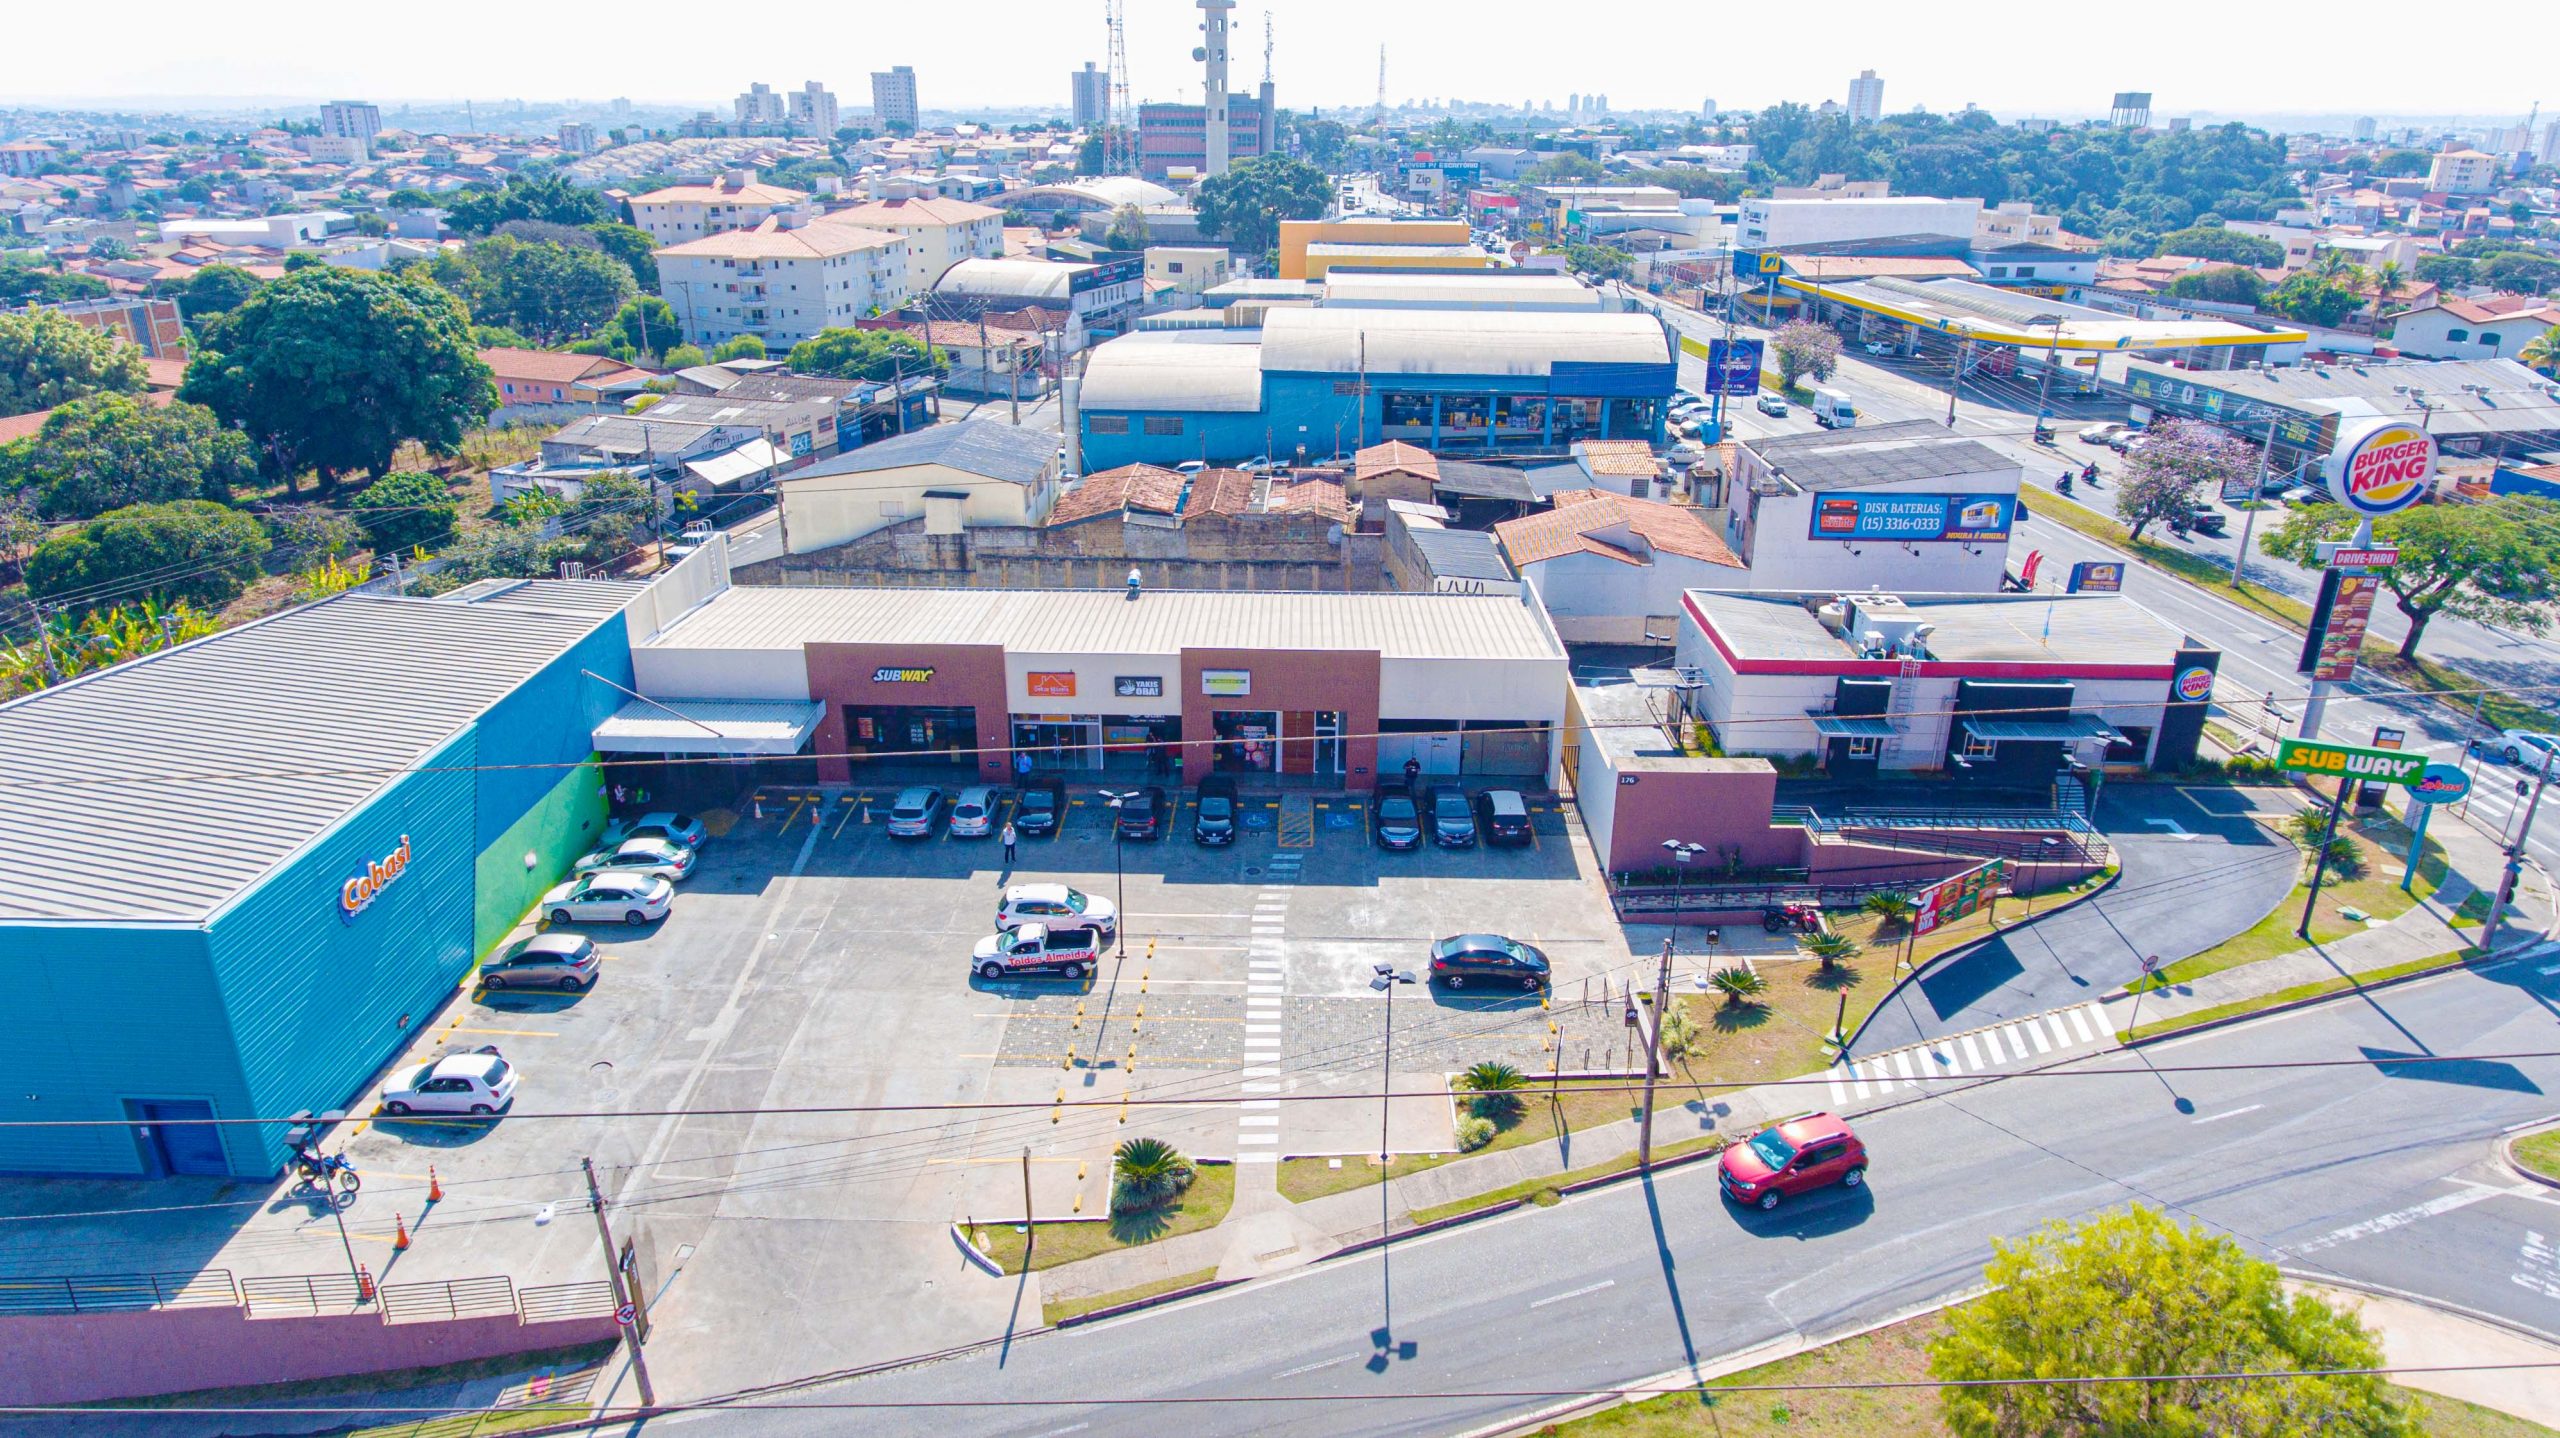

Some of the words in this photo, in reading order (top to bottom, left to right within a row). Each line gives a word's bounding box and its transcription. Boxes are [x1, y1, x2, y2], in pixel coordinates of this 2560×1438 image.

[2354, 440, 2429, 471] BURGER
[2351, 456, 2427, 494] KING
[1865, 502, 1888, 513] DISK
[1891, 503, 1943, 514] BATERIAS:
[1862, 516, 1883, 531] (15)
[1885, 517, 1940, 530] 3316-0333
[2336, 554, 2394, 564] DRIVE-THRU
[873, 668, 933, 682] SUBWAY
[1135, 688, 1159, 696] OBA!
[2182, 681, 2211, 692] KING
[2286, 748, 2420, 778] SUBWAY
[341, 834, 411, 911] Cobasi
[1008, 956, 1043, 967] Toldos
[1045, 949, 1089, 962] Almeida
